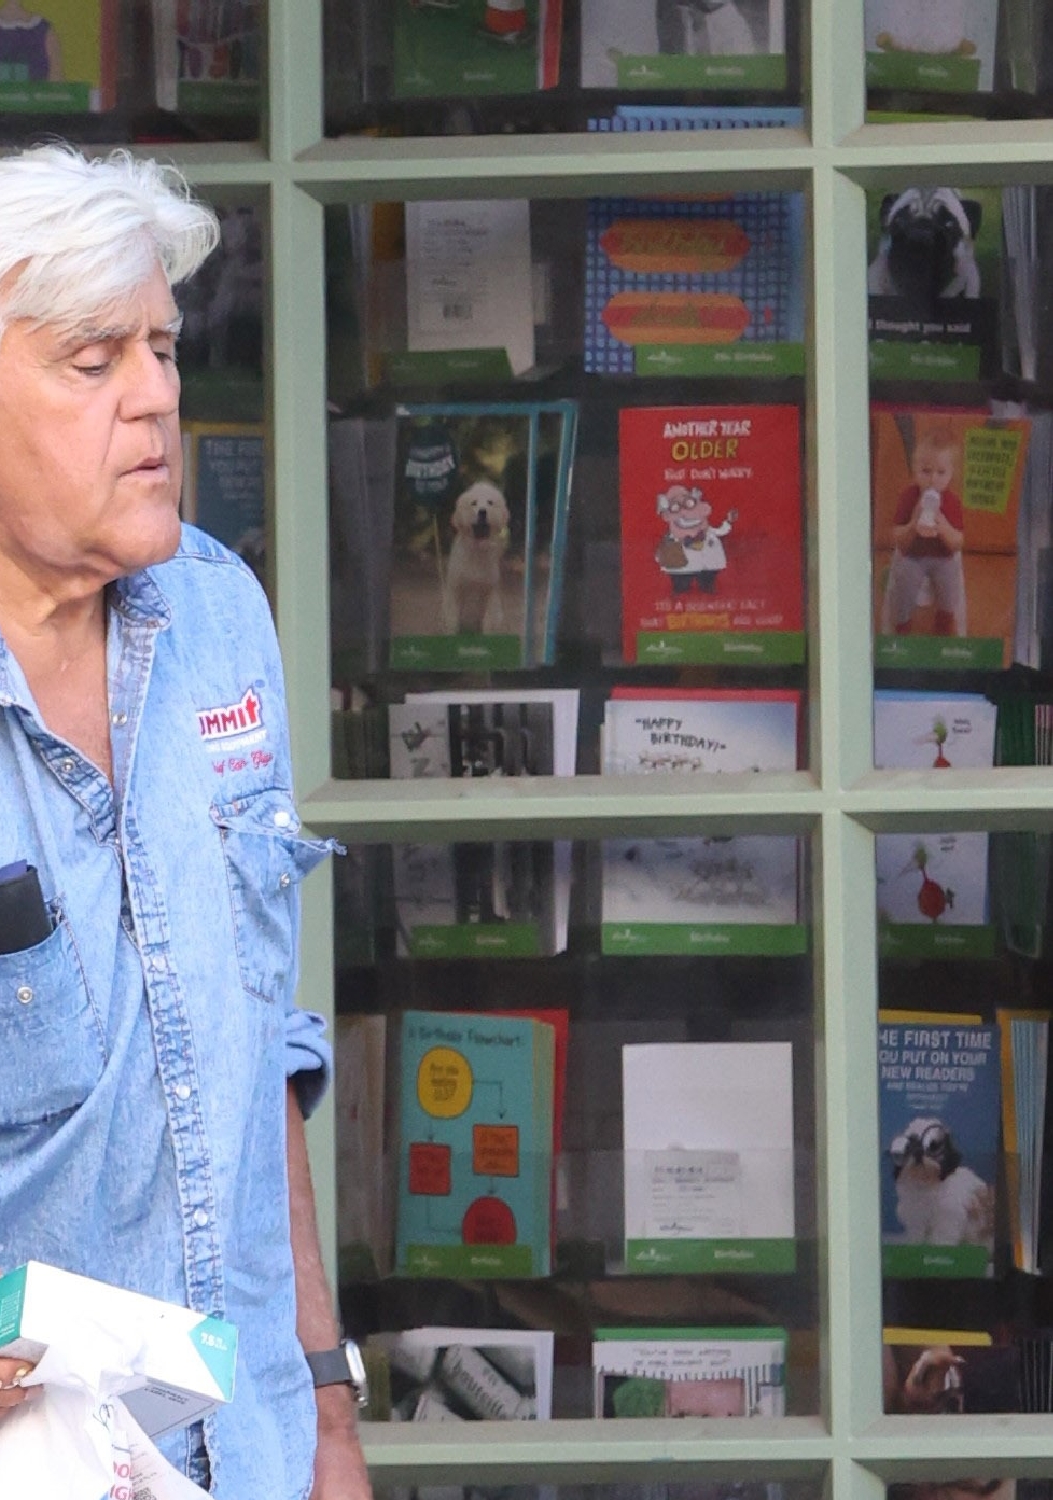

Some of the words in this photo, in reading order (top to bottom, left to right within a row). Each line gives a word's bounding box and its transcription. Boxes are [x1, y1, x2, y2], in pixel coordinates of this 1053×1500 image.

[663, 420, 718, 438] ANOTHER
[720, 419, 752, 437] YEAR
[671, 438, 739, 461] OLDER
[904, 1029, 951, 1049] FIRST
[954, 1031, 992, 1050] TIME
[902, 1050, 927, 1064] PUT
[929, 1051, 949, 1065] ON
[952, 1051, 987, 1066] YOUR
[881, 1065, 912, 1080] NEW
[914, 1066, 976, 1081] READERS
